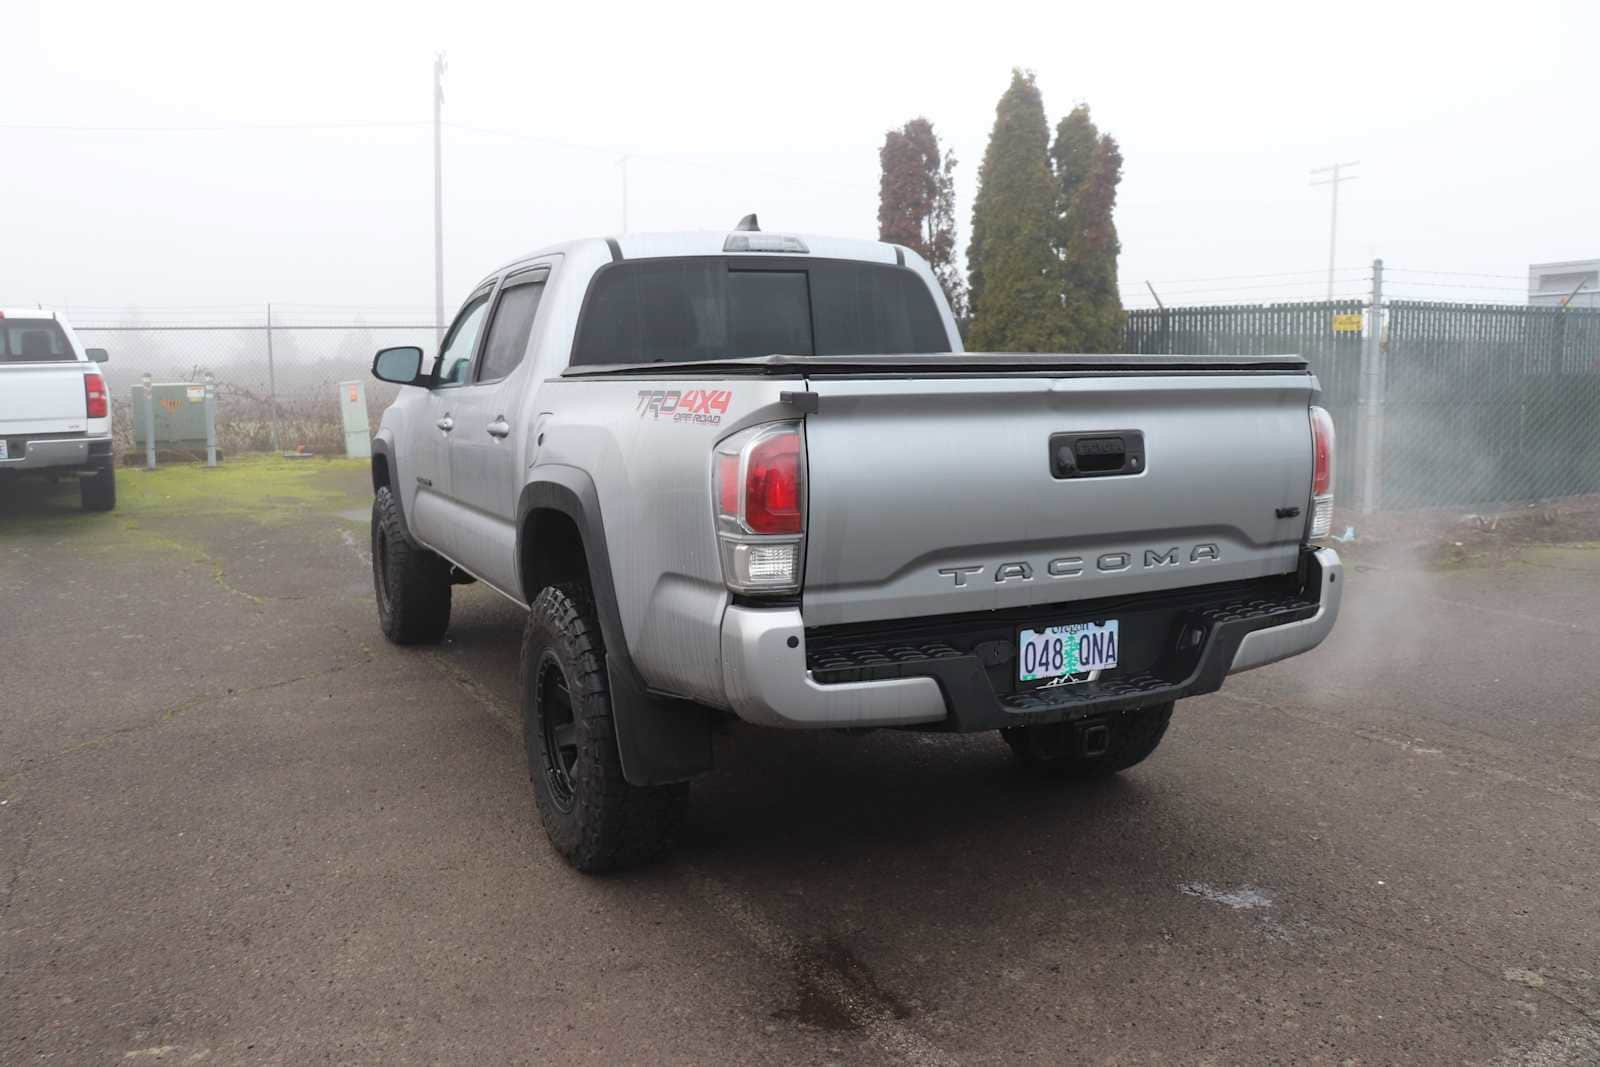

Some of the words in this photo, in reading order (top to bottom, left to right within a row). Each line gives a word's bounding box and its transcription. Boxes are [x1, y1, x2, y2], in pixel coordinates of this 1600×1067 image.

[637, 390, 681, 417] TRD
[673, 412, 692, 422] OFF
[693, 414, 720, 424] ROAD
[938, 543, 1220, 587] TACOMA
[1024, 638, 1063, 673] 048
[1079, 631, 1116, 666] QNA
